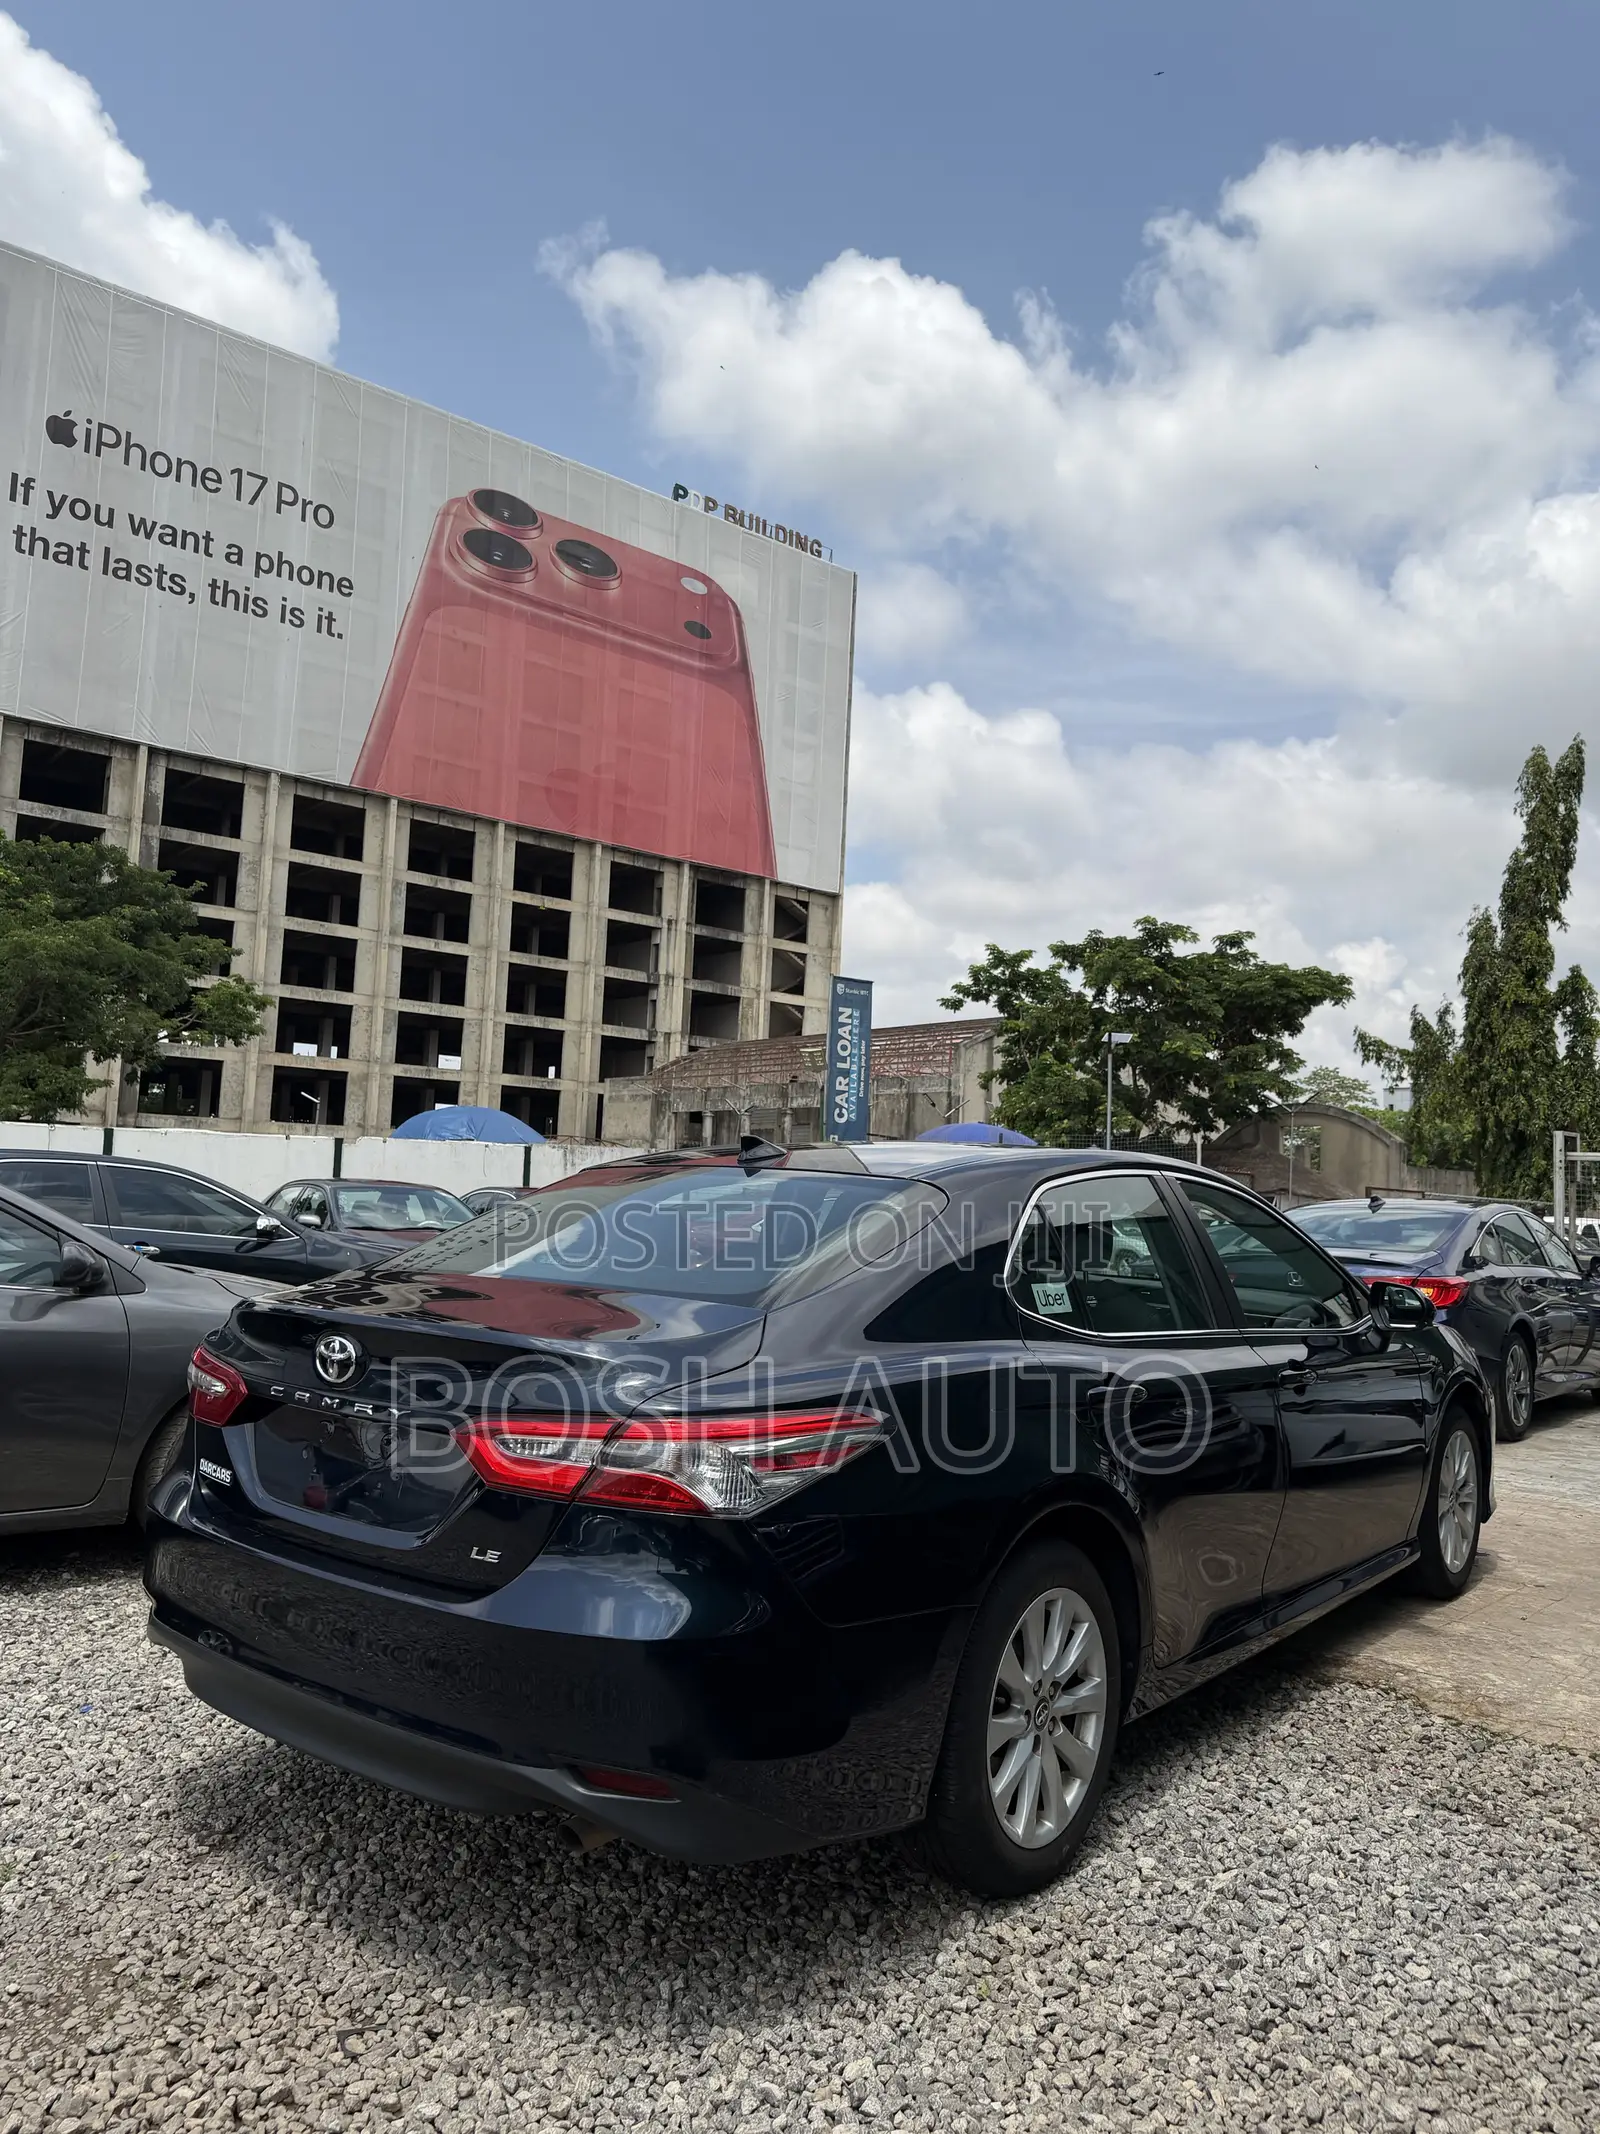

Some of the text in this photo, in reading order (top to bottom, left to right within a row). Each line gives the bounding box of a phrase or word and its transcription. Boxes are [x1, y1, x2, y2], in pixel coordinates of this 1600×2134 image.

[83, 418, 335, 529] iPhone 17 Pro
[8, 472, 354, 598] If you want a phone
[673, 482, 823, 559] PDP BUILDING
[12, 524, 344, 640] that lasts, this is it.
[834, 1006, 853, 1124] CAR LOAN
[849, 1010, 860, 1120] AVAILABLE HERE
[1037, 1289, 1066, 1308] Uber
[270, 1385, 412, 1420] CAMRY
[200, 1457, 233, 1483] DARCARS
[469, 1546, 502, 1564] LE
